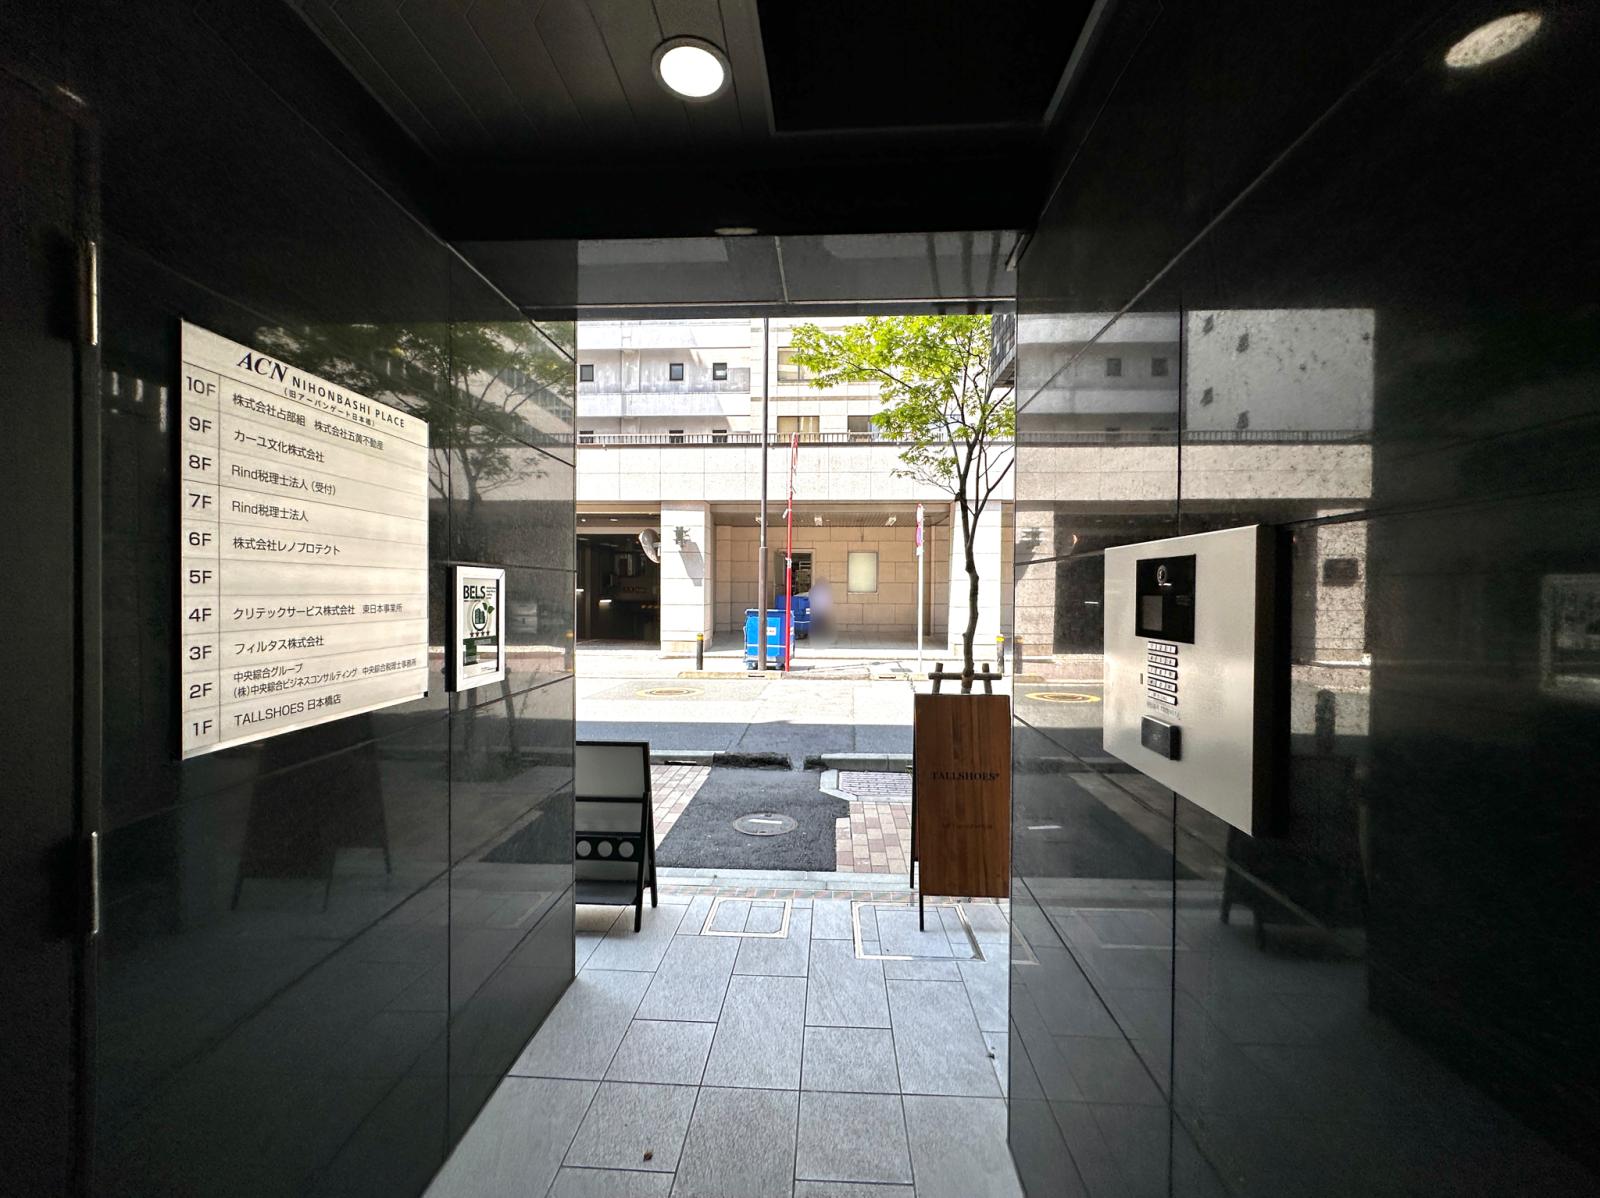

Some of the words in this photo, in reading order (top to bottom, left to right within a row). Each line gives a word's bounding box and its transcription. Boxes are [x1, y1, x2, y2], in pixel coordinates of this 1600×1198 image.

[186, 376, 216, 396] 10F
[233, 393, 305, 427] 株式会社占部組
[237, 351, 288, 383] ACN
[292, 376, 371, 415] NIHONBASHI
[375, 409, 405, 428] PLACE
[189, 417, 212, 433] 9F
[234, 429, 324, 463] カーユ文化株式会社
[189, 455, 211, 470] 8F
[189, 493, 212, 509] 7F
[232, 501, 308, 522] Rind税理士法人
[189, 532, 211, 546] 6F
[233, 537, 340, 556] 株式会社レノプロテクト
[189, 570, 211, 584] 5F
[463, 585, 486, 599] BELS
[189, 608, 212, 622] 4F
[233, 605, 355, 621] クリテックサービス株式会社
[189, 646, 212, 660] 3F
[235, 636, 324, 655] フィルタス株式会社
[190, 683, 212, 698] 2F
[193, 720, 212, 736] 1F
[234, 702, 304, 726] TALLSHOES
[307, 694, 341, 710] 日本橋店
